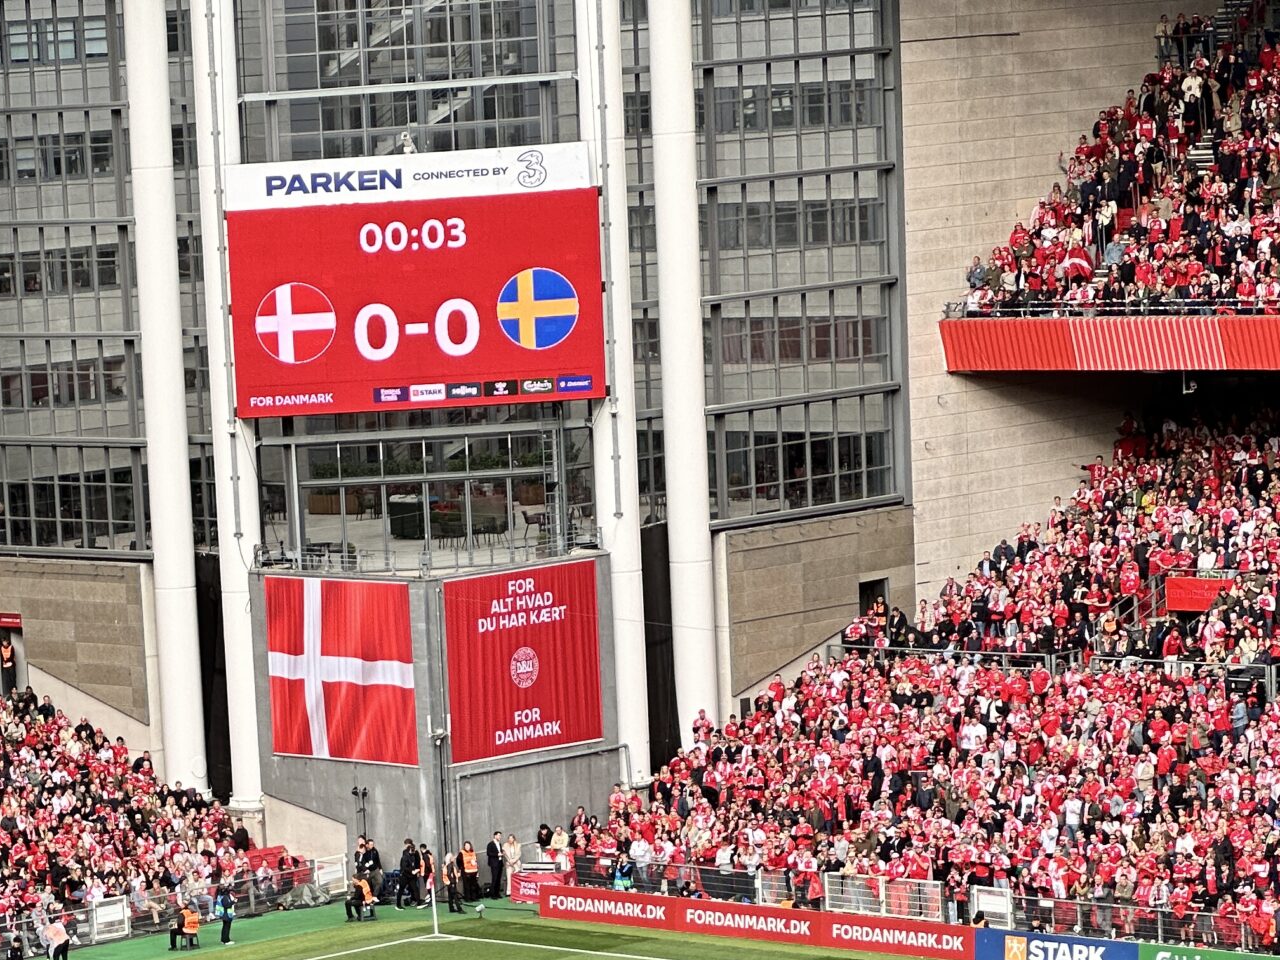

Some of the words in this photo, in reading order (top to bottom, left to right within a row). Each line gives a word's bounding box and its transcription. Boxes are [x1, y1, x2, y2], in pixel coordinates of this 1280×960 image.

[265, 168, 403, 197] PARKEN
[412, 167, 490, 182] CONNECTED
[492, 166, 509, 177] BY
[517, 150, 547, 188] 3
[359, 217, 467, 253] 00:03
[354, 298, 480, 361] 0-0
[250, 395, 274, 407] FOR
[275, 393, 333, 406] DANMARK
[419, 388, 443, 396] STARK
[507, 577, 535, 595] FOR
[490, 597, 514, 615] ALT
[516, 591, 553, 611] HVAD
[477, 617, 497, 633] DU
[499, 612, 527, 630] HAR
[529, 605, 567, 625] KÆRT
[513, 707, 541, 725] FOR
[495, 720, 562, 745] DANMARK
[549, 894, 666, 921] FORDANMARK.DK
[686, 907, 811, 936] FORDANMARK.DK
[831, 923, 964, 952] FORDANMARK.DK
